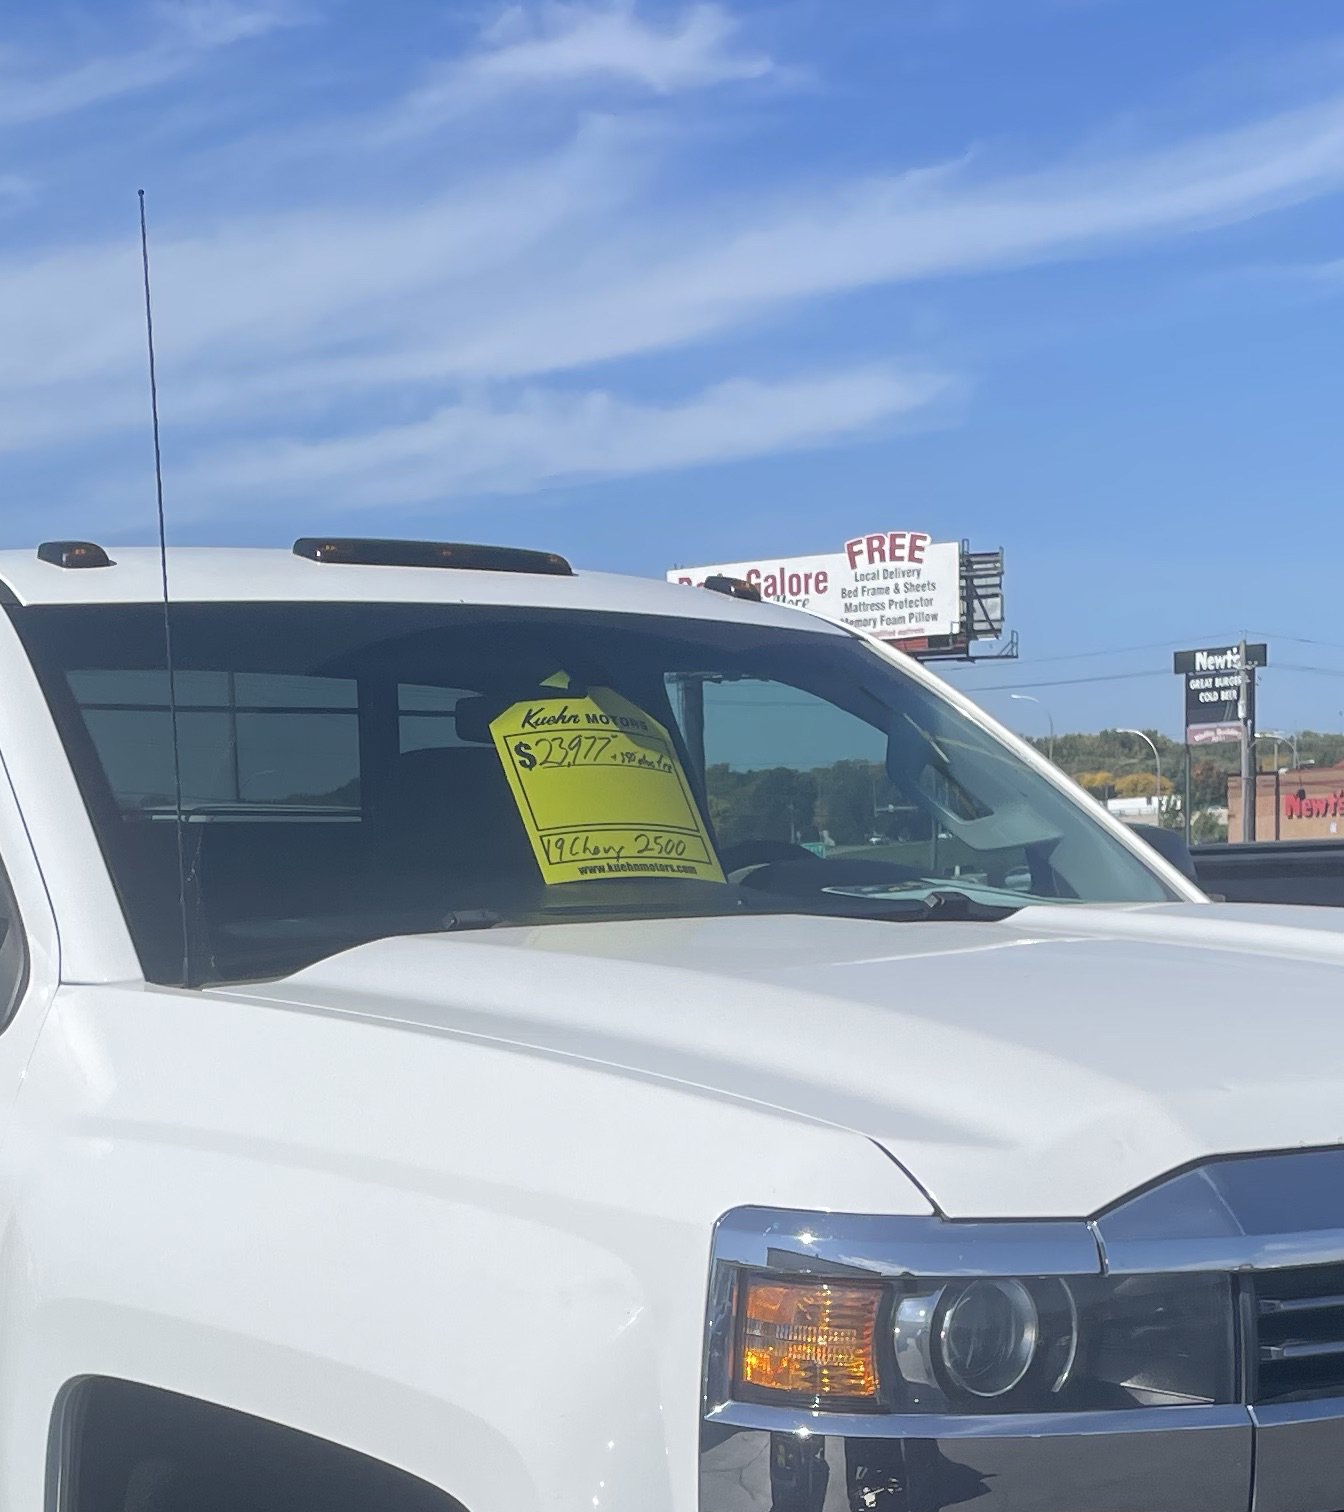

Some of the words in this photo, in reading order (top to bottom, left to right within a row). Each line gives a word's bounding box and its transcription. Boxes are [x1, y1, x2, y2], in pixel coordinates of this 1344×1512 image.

[846, 533, 928, 570] FREE
[854, 569, 880, 582] Local
[882, 567, 921, 580] Delivery
[841, 587, 858, 599] Bed
[861, 585, 890, 597] Frame
[893, 583, 901, 595] &
[903, 580, 936, 594] Sheets
[844, 601, 886, 613] Mattress
[888, 597, 933, 610] Protector
[880, 614, 906, 626] Foam
[908, 611, 939, 623] Pillow
[1195, 647, 1241, 671] Newt's
[1189, 677, 1213, 690] GREAT
[1215, 675, 1244, 688] BURGER
[1198, 690, 1219, 703] COLD
[1220, 689, 1237, 701] BEER
[521, 706, 581, 730] Kuehn
[586, 713, 648, 731] MOTORS
[634, 834, 686, 856] 2500
[577, 862, 698, 876] www.kuehnmotors.com
